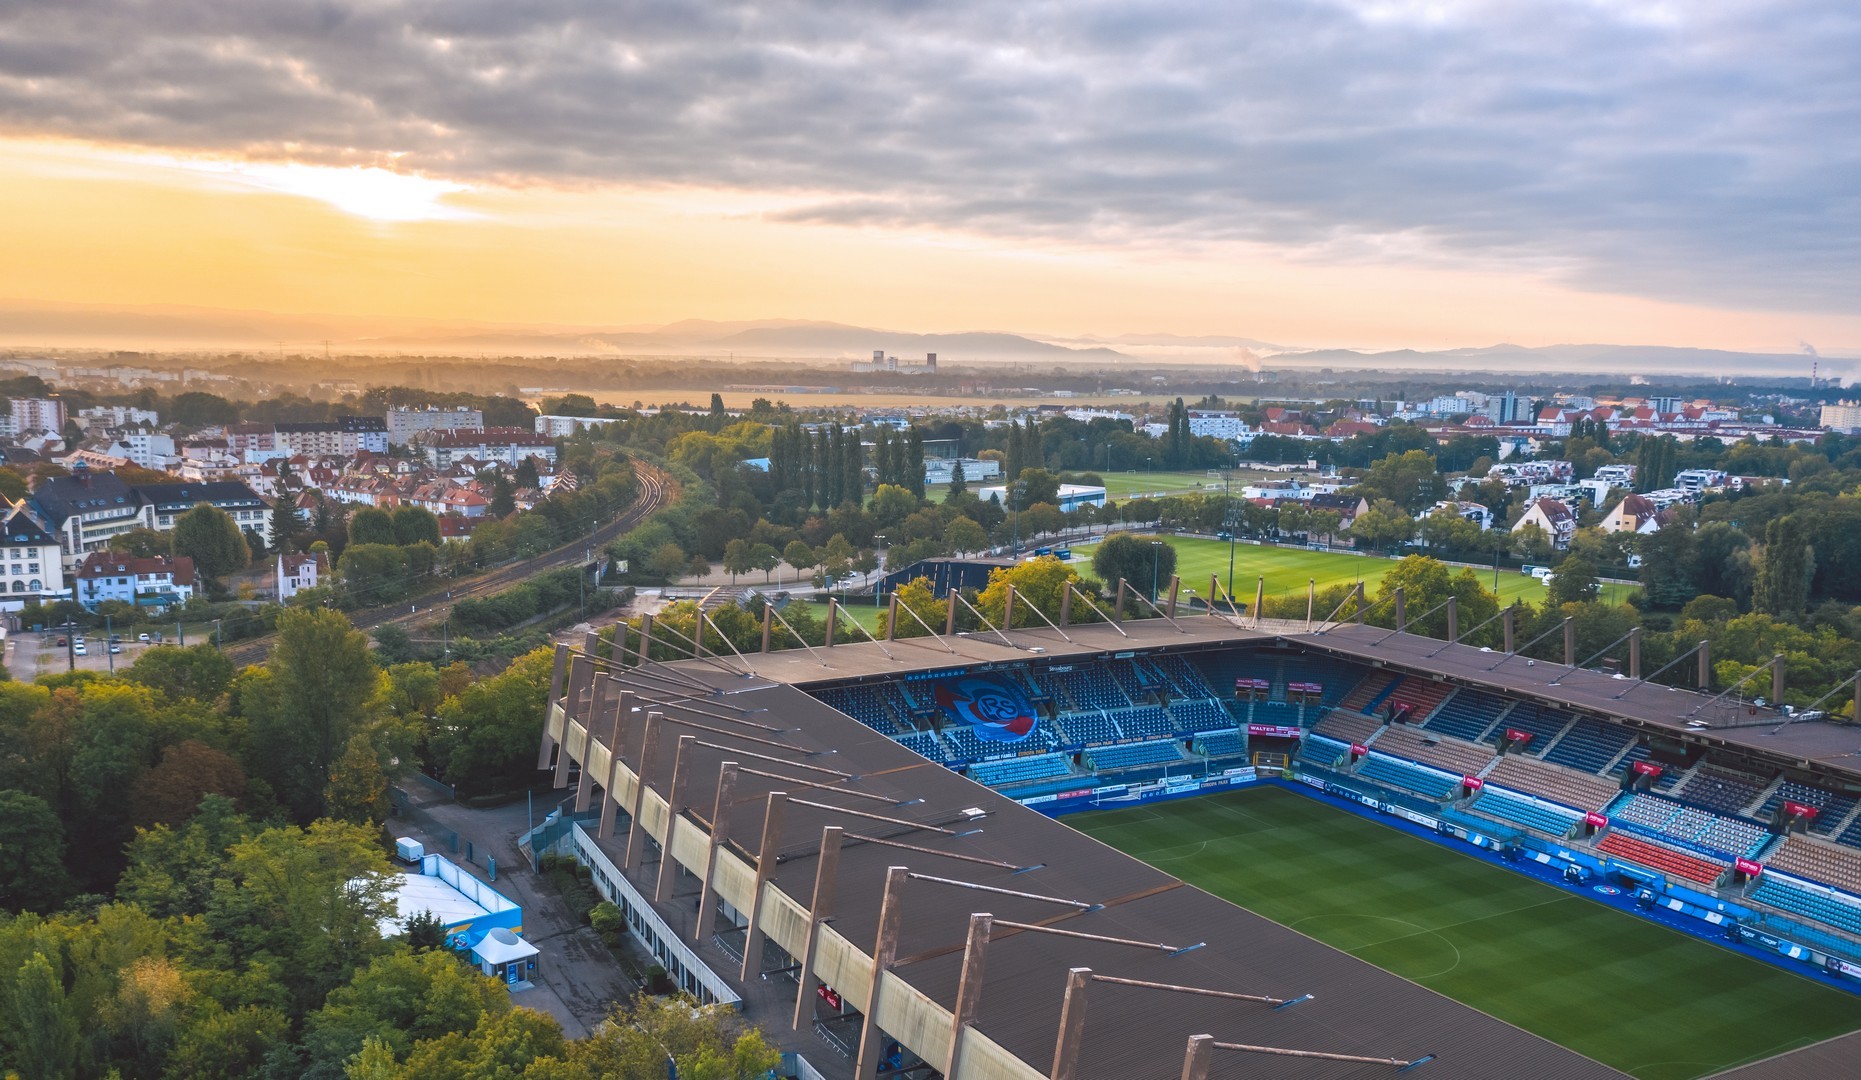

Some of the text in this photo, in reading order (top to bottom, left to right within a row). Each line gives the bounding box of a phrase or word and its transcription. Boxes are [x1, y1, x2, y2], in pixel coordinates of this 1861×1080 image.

[1627, 825, 1645, 835] RACING
[1644, 830, 1658, 839] CLUB
[1665, 835, 1696, 851] STRASBOURG
[1696, 847, 1716, 857] ALSACE
